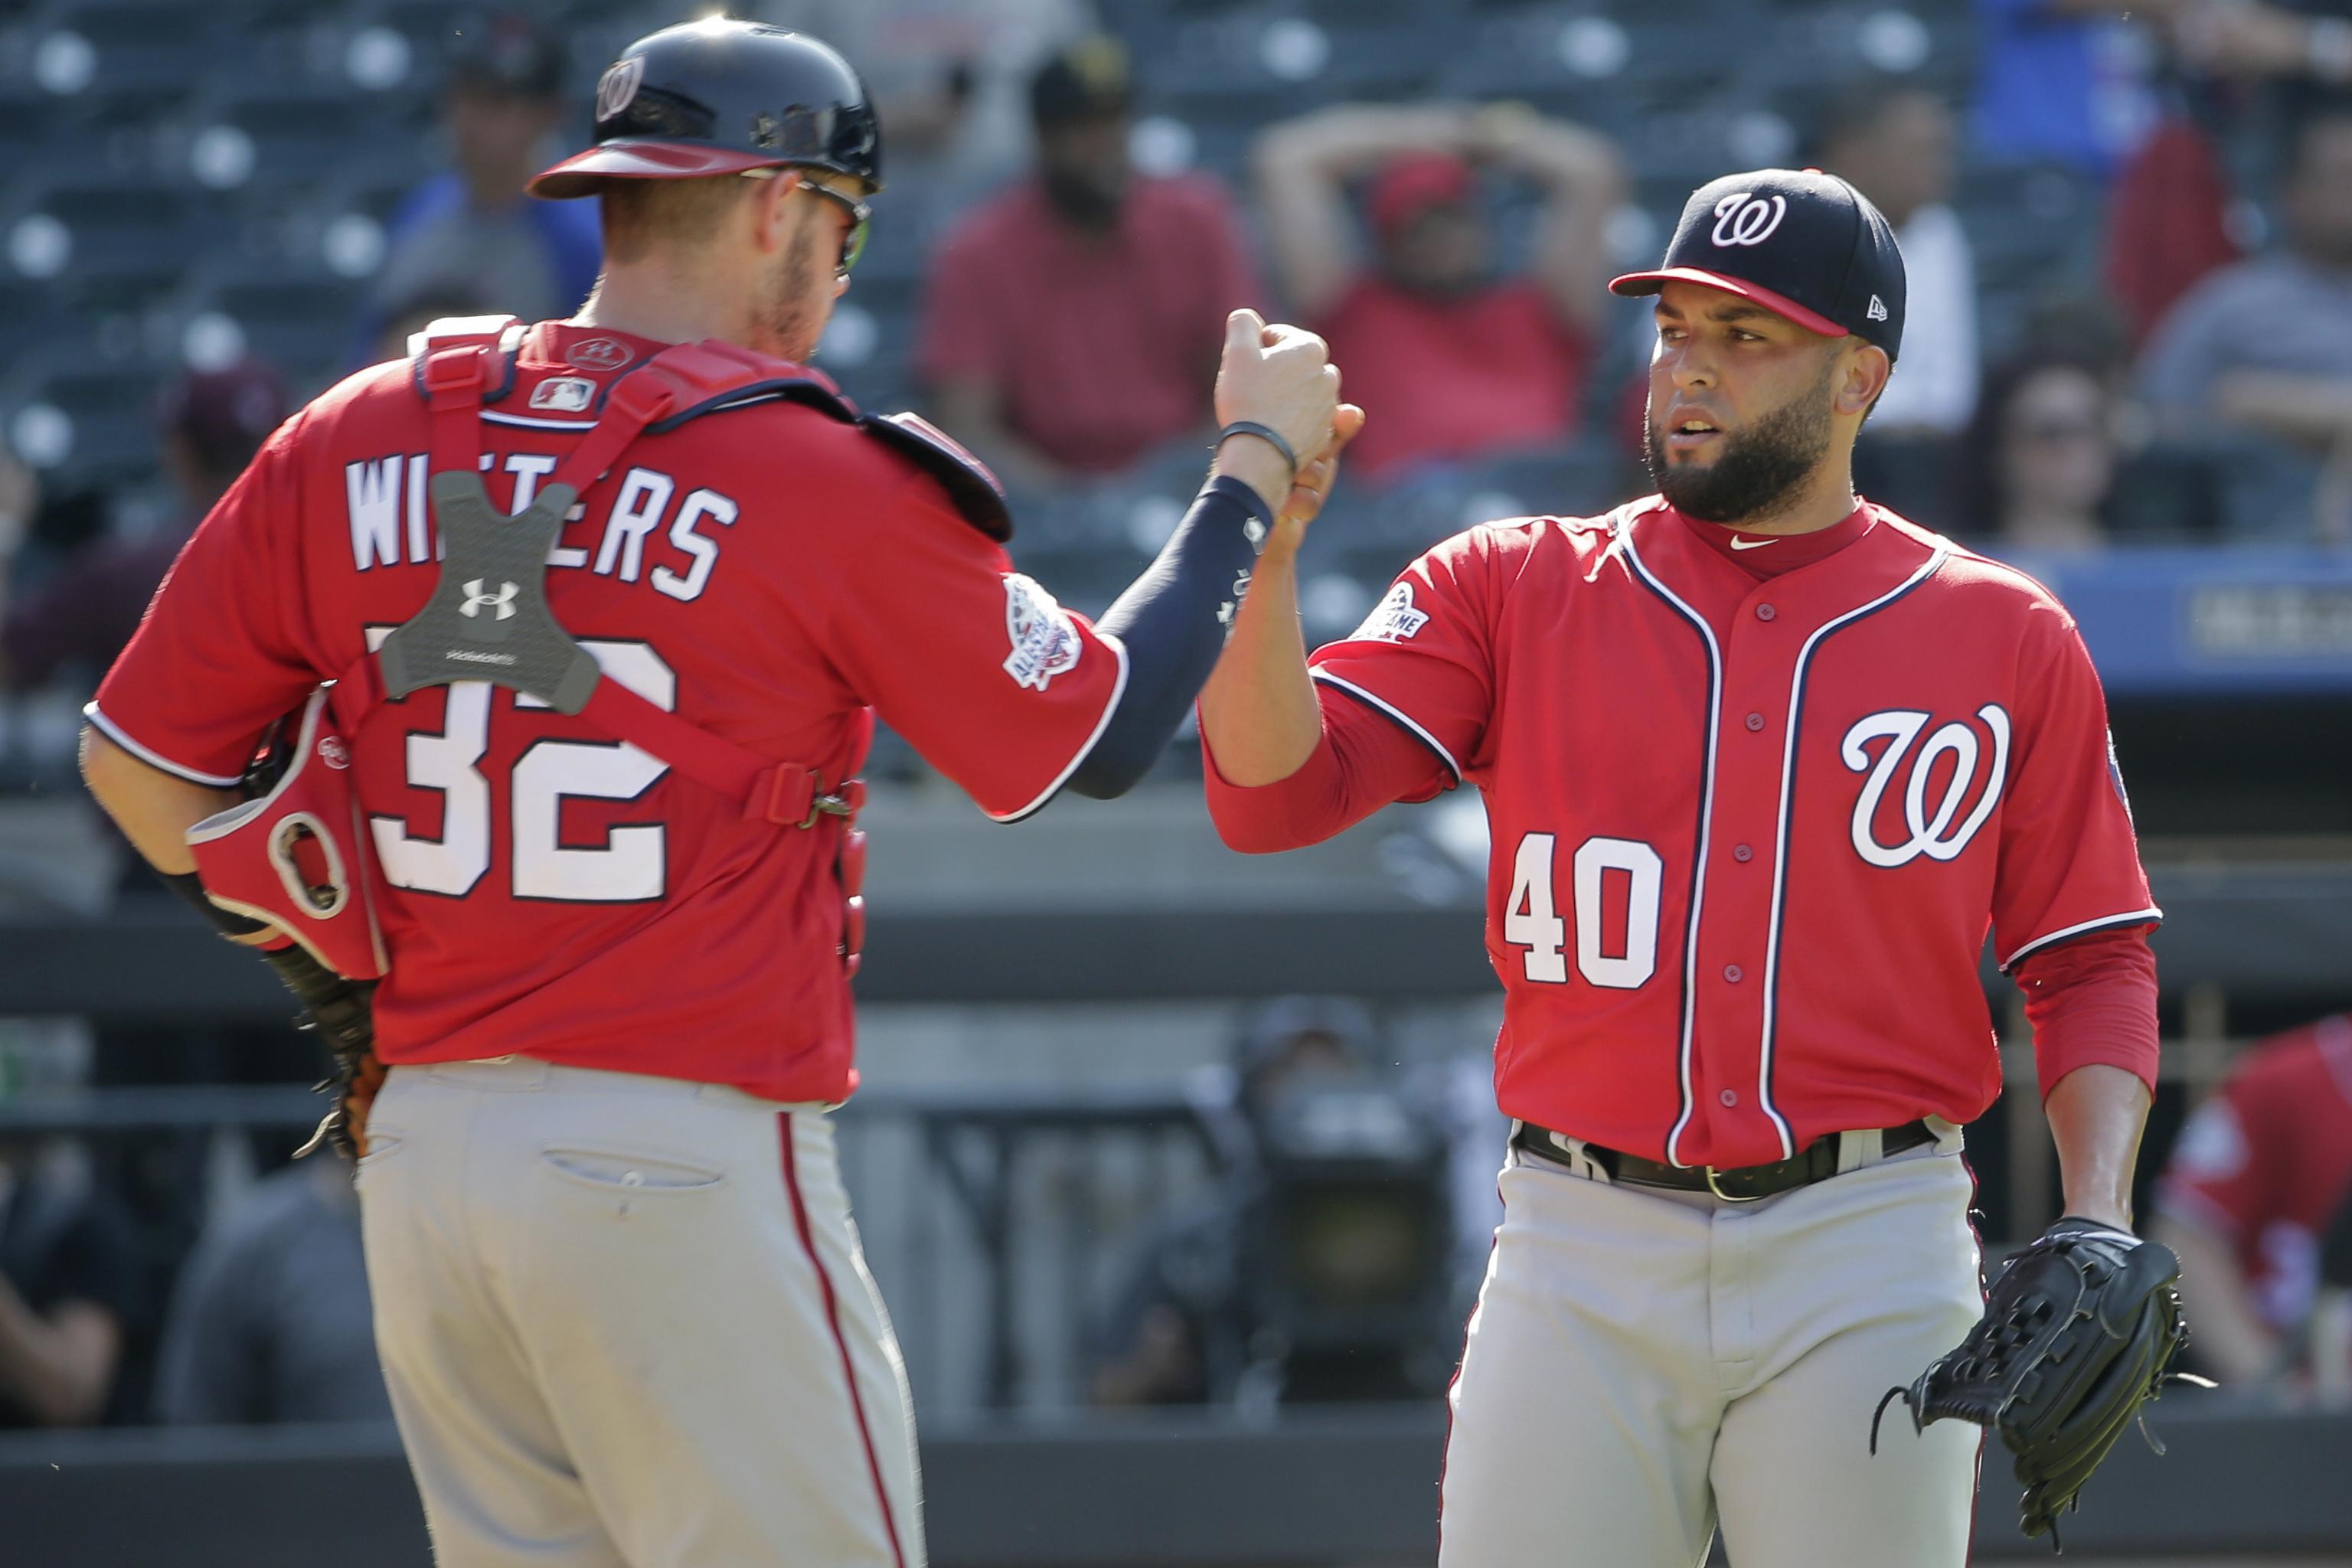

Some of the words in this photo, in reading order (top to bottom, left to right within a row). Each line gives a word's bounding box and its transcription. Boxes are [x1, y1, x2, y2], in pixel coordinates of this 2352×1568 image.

[1711, 193, 1787, 247] W
[345, 453, 738, 602] WITERS
[363, 622, 678, 903] 32
[1842, 704, 2011, 868] W
[1504, 832, 1664, 989] 40
